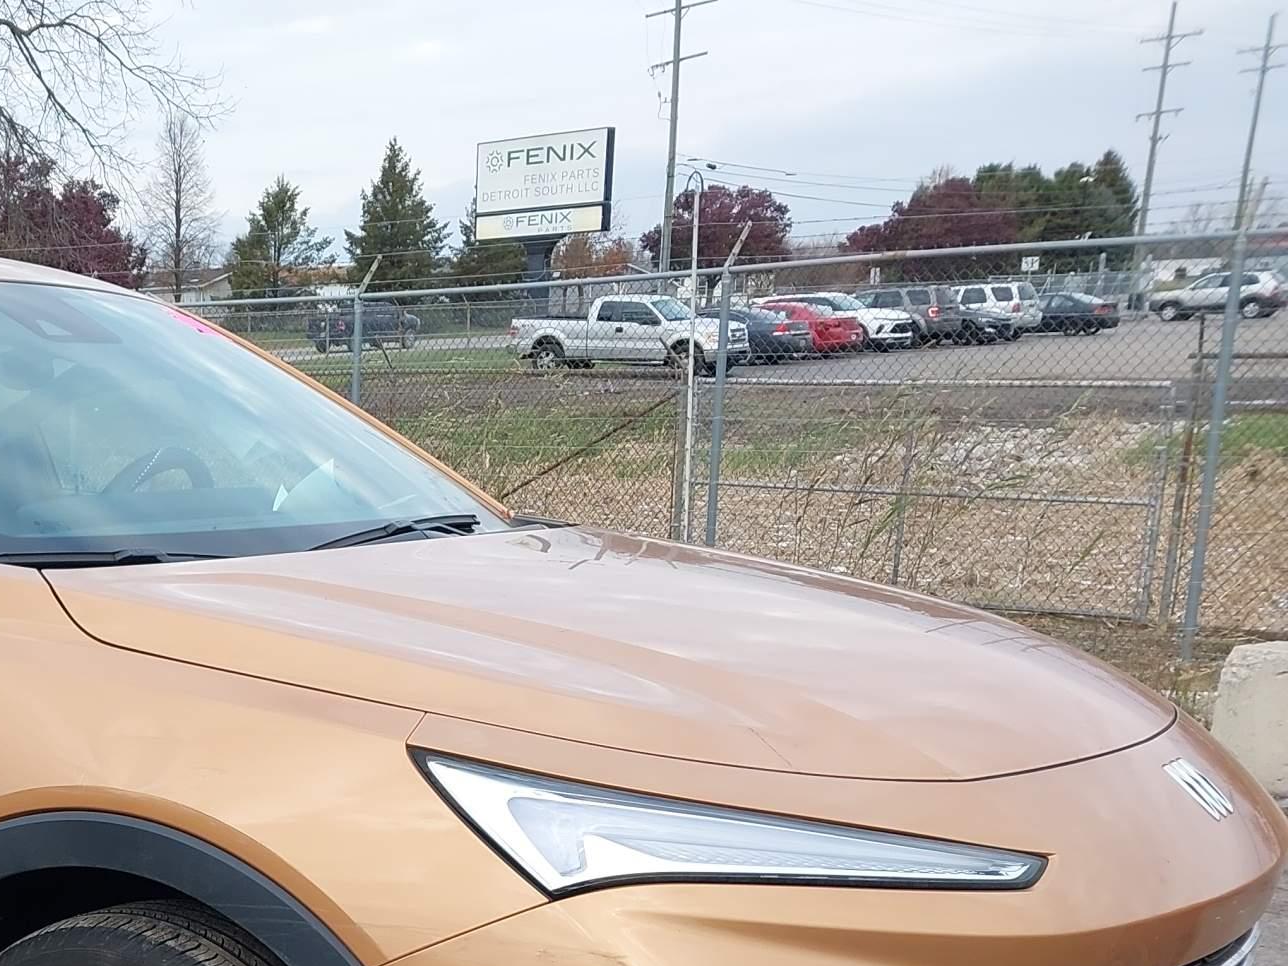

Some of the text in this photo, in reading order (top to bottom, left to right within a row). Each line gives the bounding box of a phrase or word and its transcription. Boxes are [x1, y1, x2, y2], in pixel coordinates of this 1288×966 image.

[507, 141, 597, 168] FENIX
[523, 168, 600, 185] FENIX PARTS
[482, 181, 599, 202] DETROIT SOUTH LLC
[515, 211, 572, 228] FENIX
